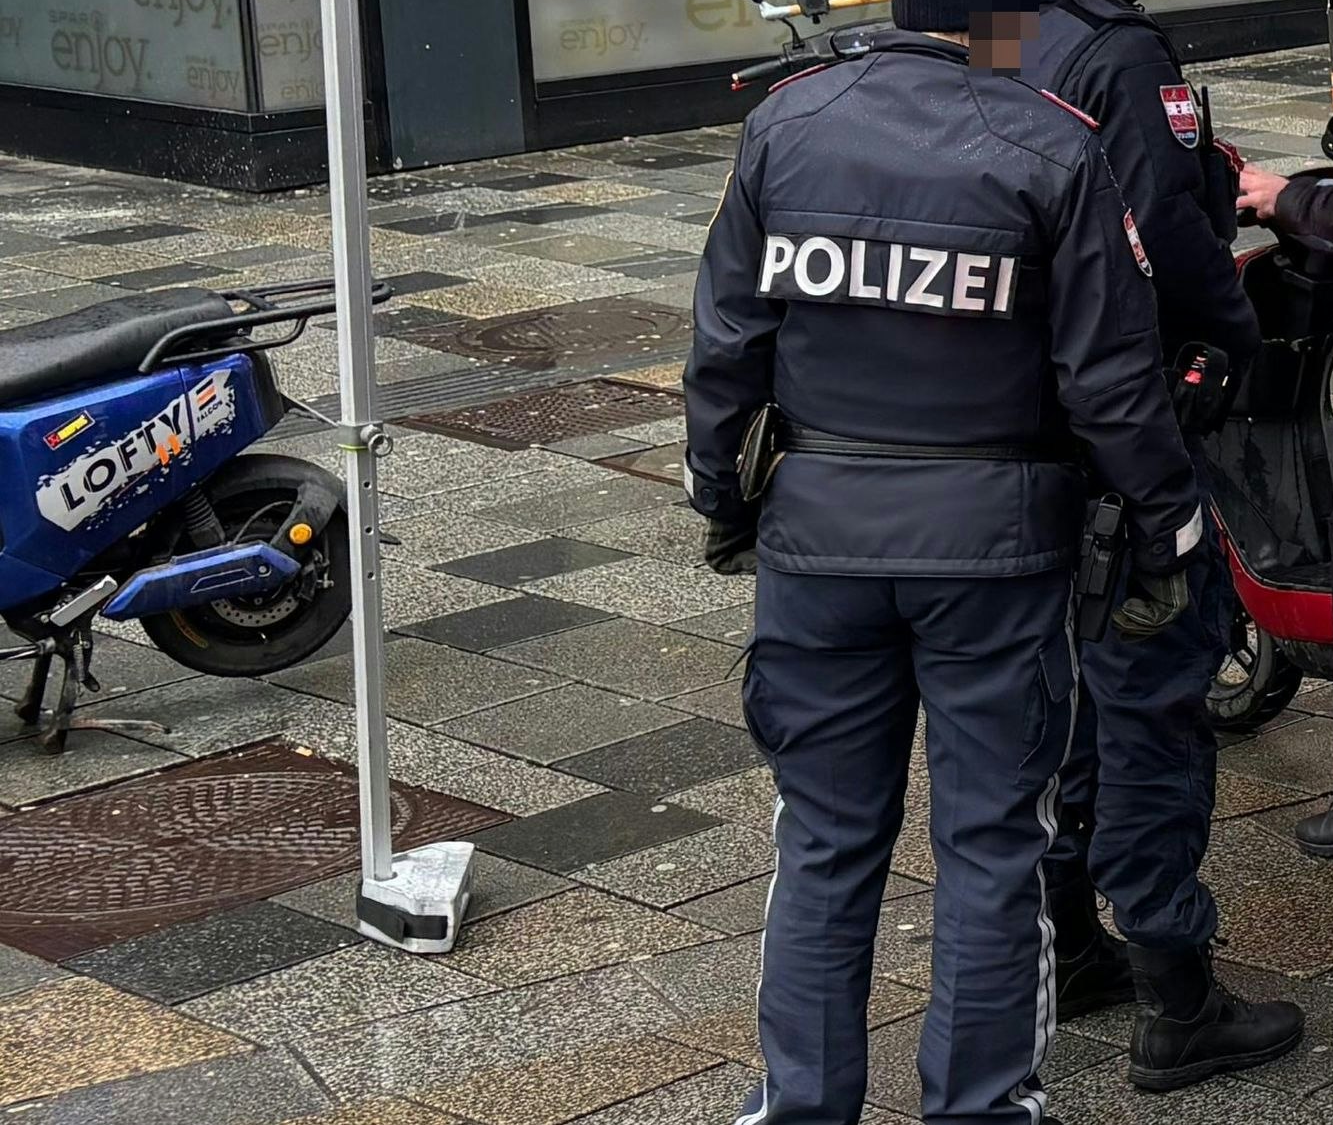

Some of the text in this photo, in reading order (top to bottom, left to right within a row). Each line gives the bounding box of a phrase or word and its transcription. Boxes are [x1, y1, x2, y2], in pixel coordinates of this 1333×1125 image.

[52, 27, 152, 93] enjoy.
[758, 235, 1018, 313] POLIZEI
[59, 401, 181, 512] LOFTY
